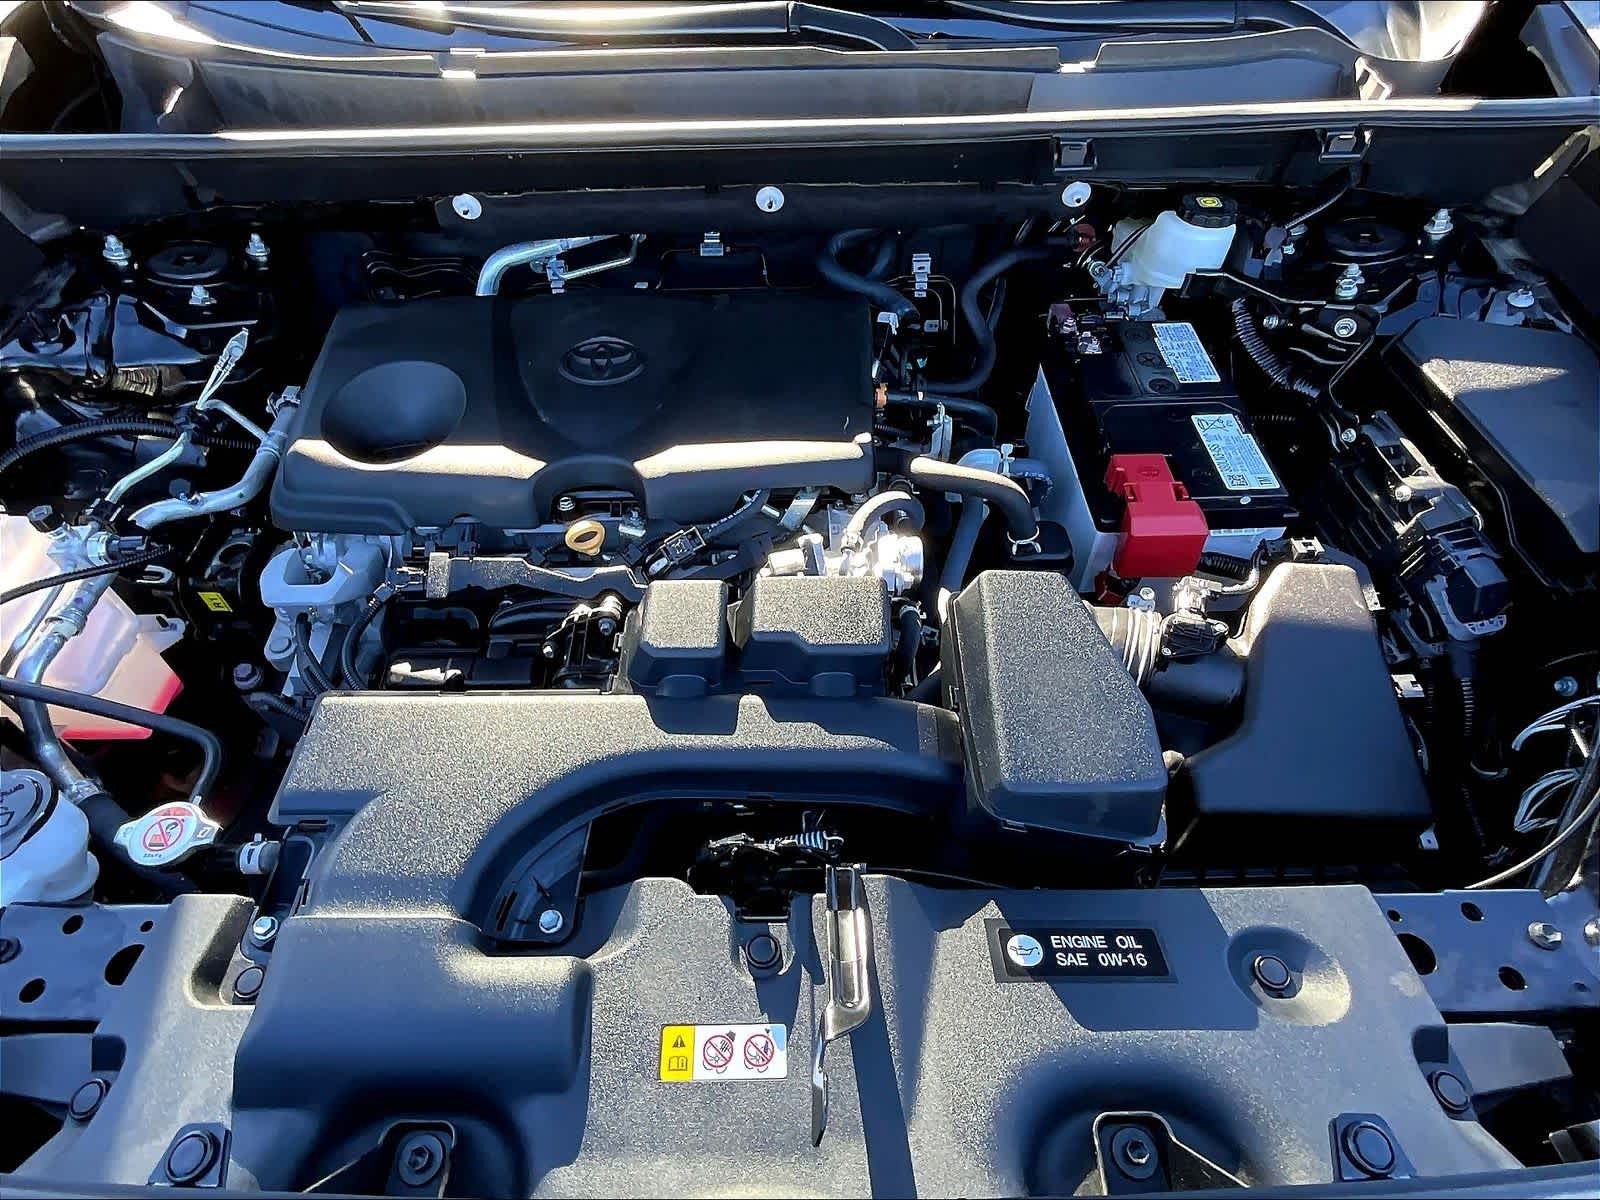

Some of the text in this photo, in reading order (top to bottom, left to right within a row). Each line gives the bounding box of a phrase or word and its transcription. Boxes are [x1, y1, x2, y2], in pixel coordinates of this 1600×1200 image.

[1050, 935, 1143, 949] ENGINE OIL
[1055, 952, 1148, 967] SAE 0W-16
